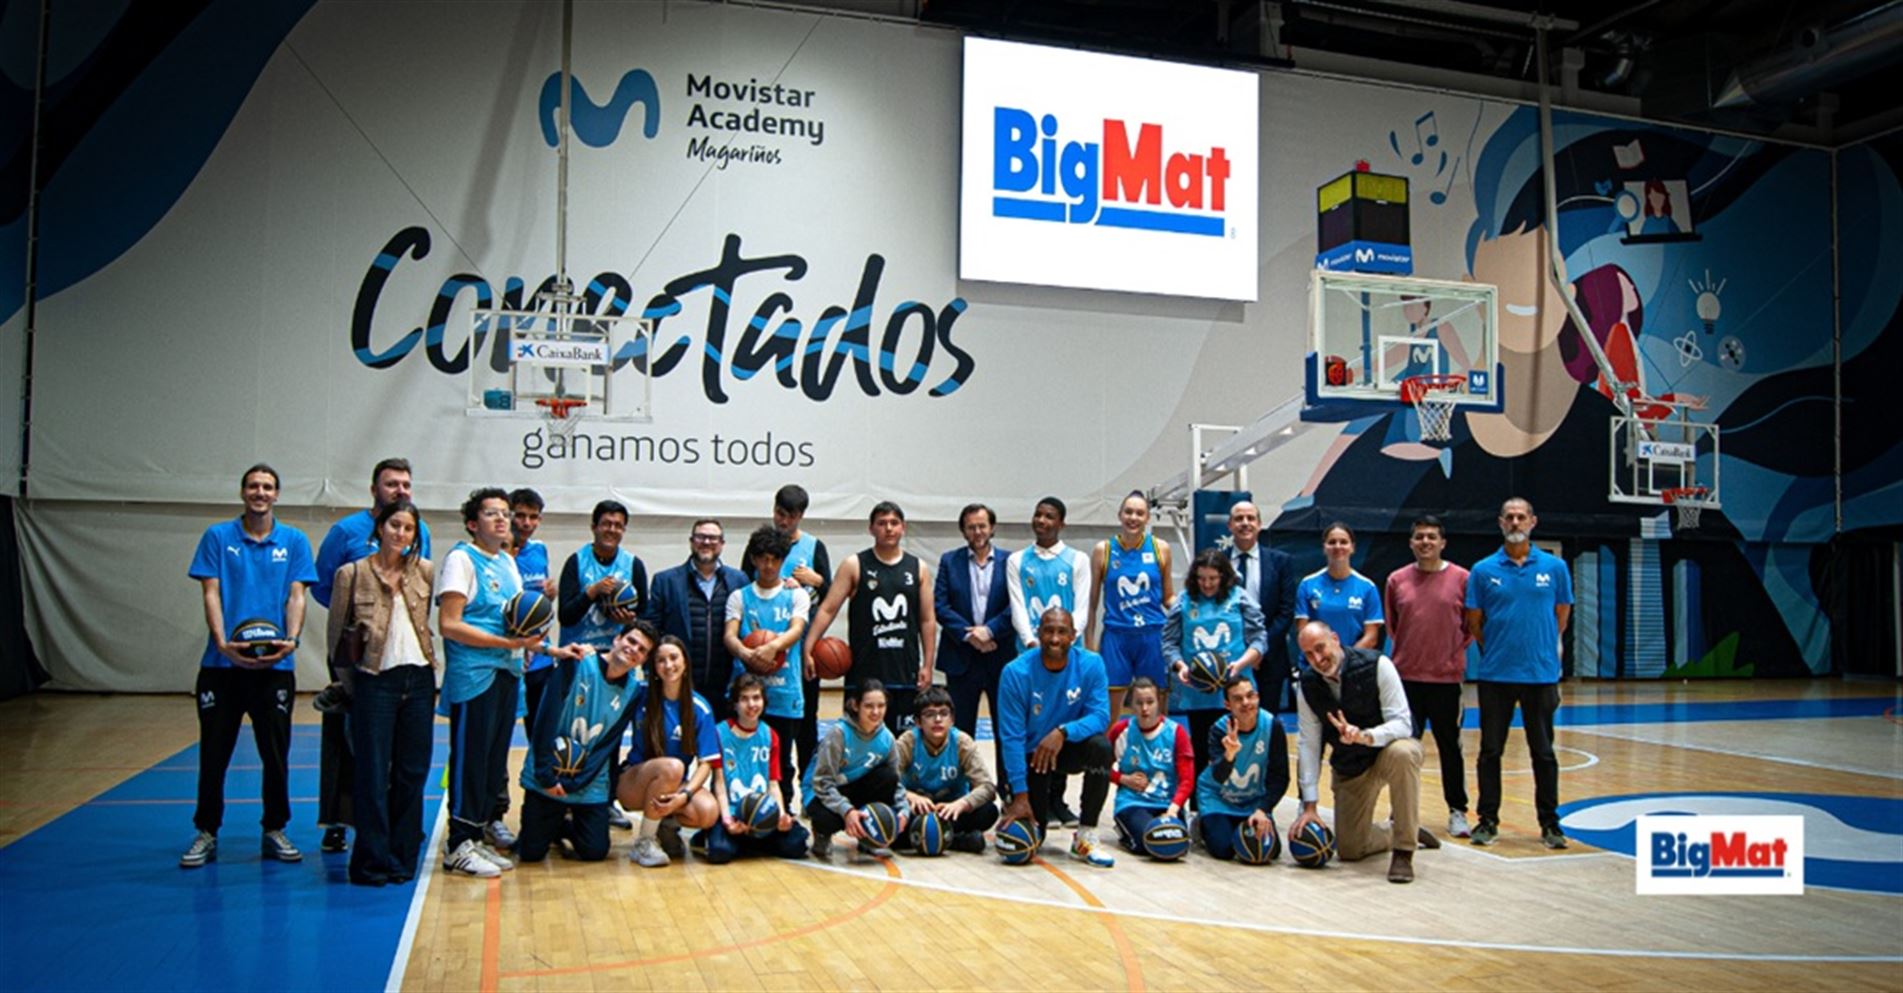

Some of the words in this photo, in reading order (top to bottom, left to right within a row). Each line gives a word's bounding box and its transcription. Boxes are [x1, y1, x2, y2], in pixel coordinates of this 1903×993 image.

[687, 73, 813, 107] Movistar
[687, 102, 824, 146] Academy
[687, 136, 781, 170] Magariños
[993, 106, 1231, 223] BigMat
[350, 226, 975, 403] Conectados
[537, 345, 602, 361] CaixaBank
[522, 428, 700, 468] ganamos
[711, 432, 815, 467] todos
[904, 571, 914, 586] 3
[1057, 572, 1068, 586] 8
[774, 606, 791, 622] 14
[610, 695, 621, 711] 4
[751, 746, 770, 762] 70
[1151, 748, 1172, 763] 43
[940, 765, 957, 780] 10
